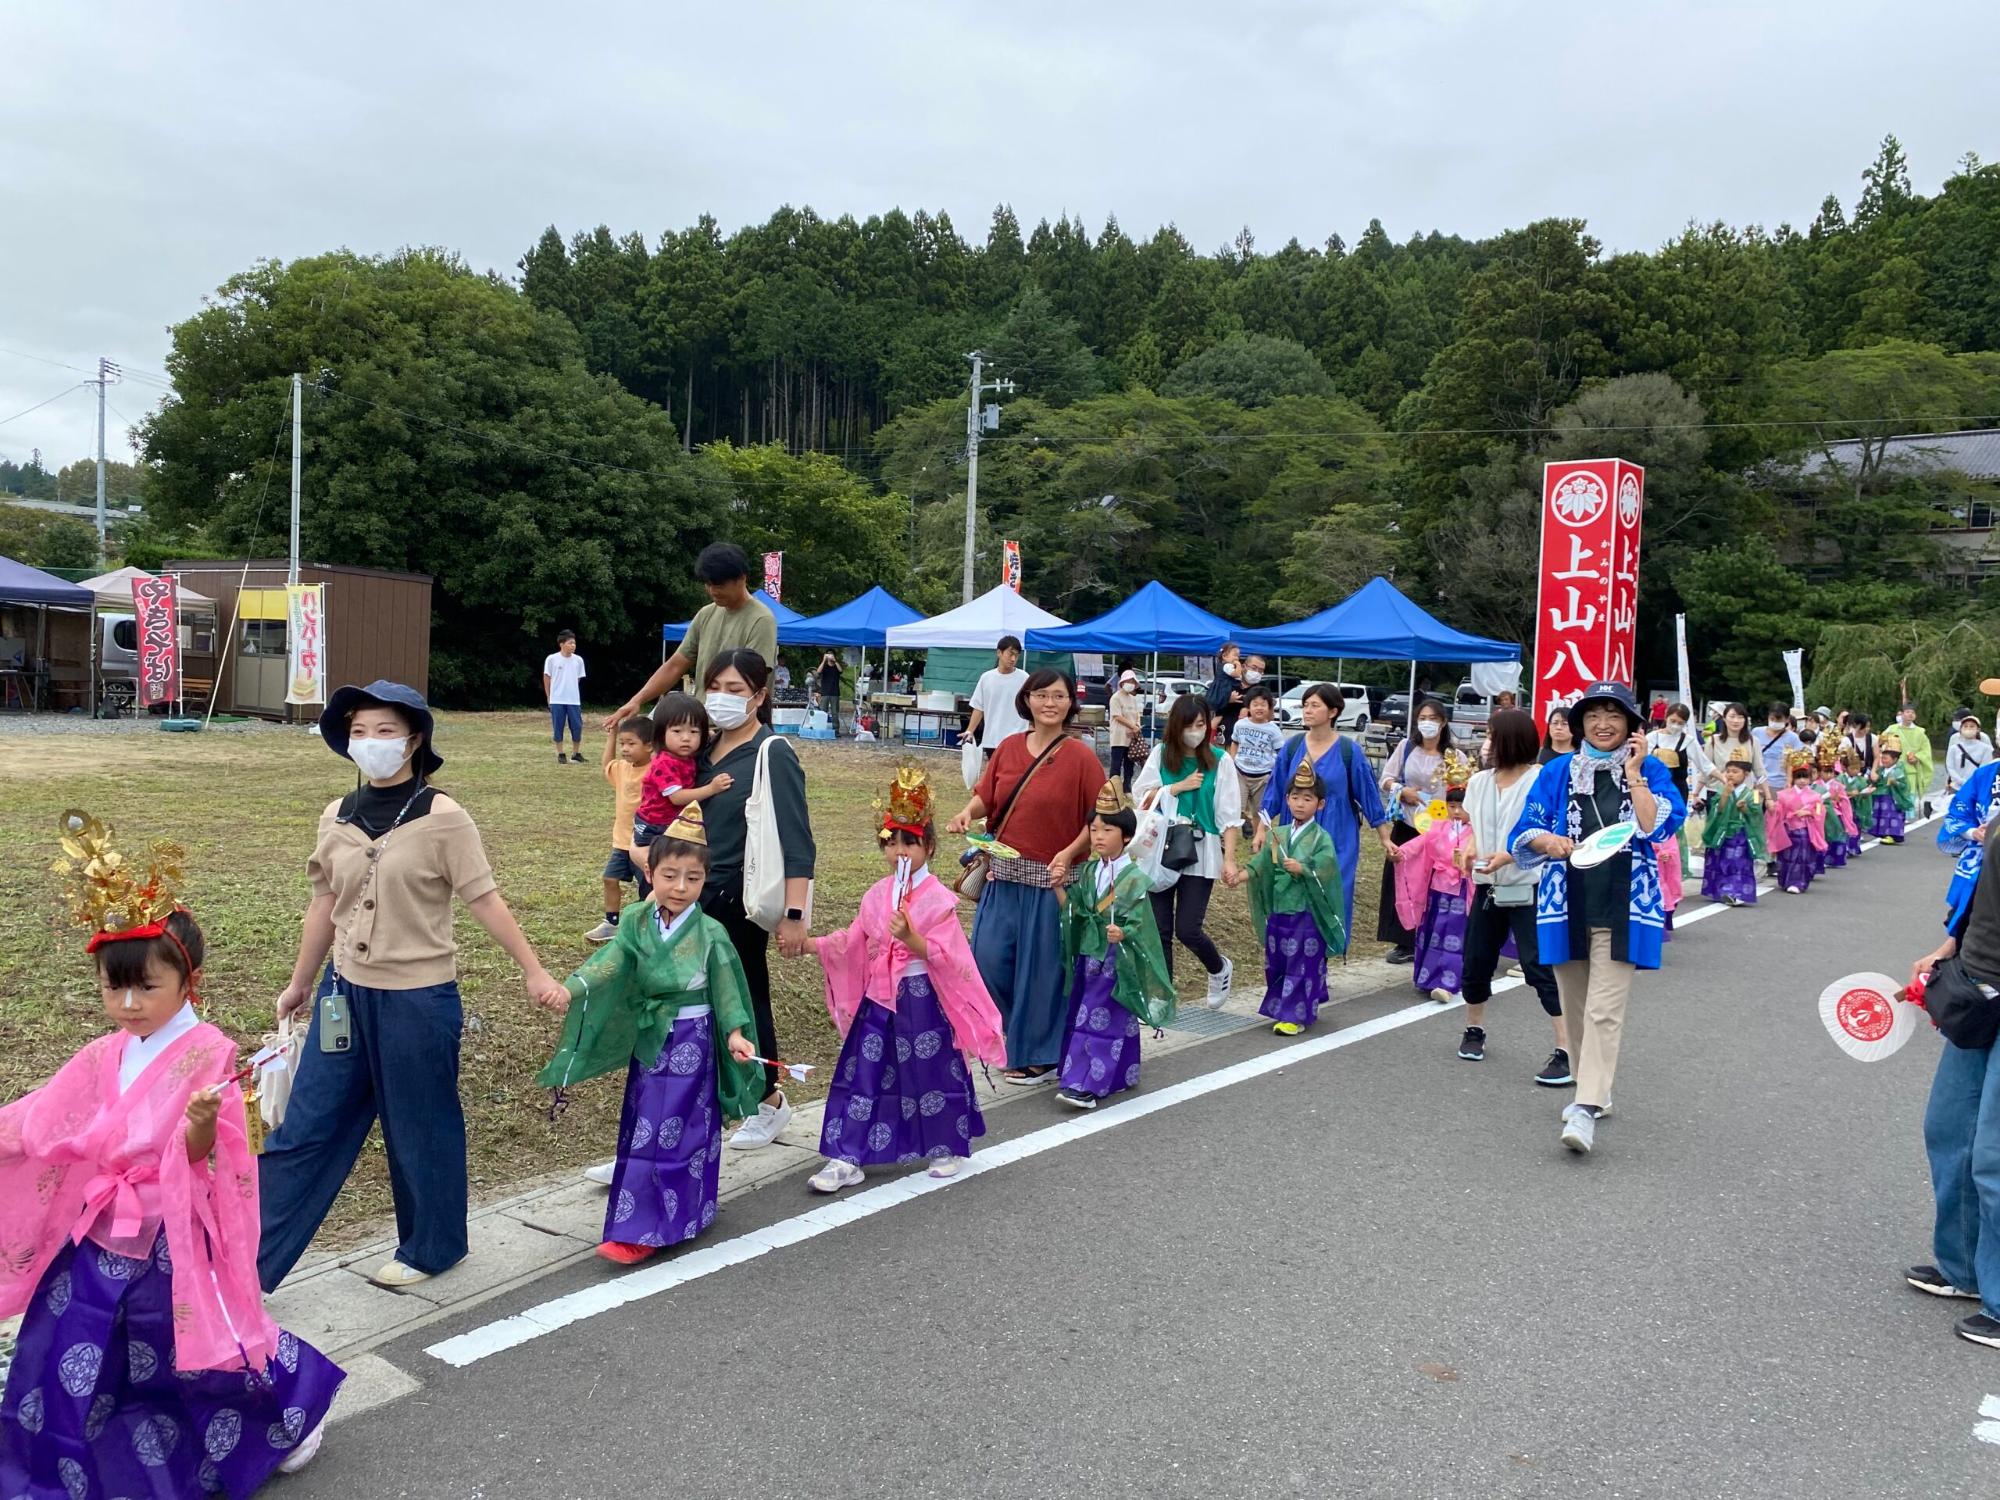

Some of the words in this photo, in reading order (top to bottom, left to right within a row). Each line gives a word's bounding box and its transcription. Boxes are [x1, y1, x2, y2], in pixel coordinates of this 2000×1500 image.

[1598, 539, 1611, 624] かみのやま
[139, 579, 172, 682] やきそば
[301, 591, 317, 680] ハンバーガー
